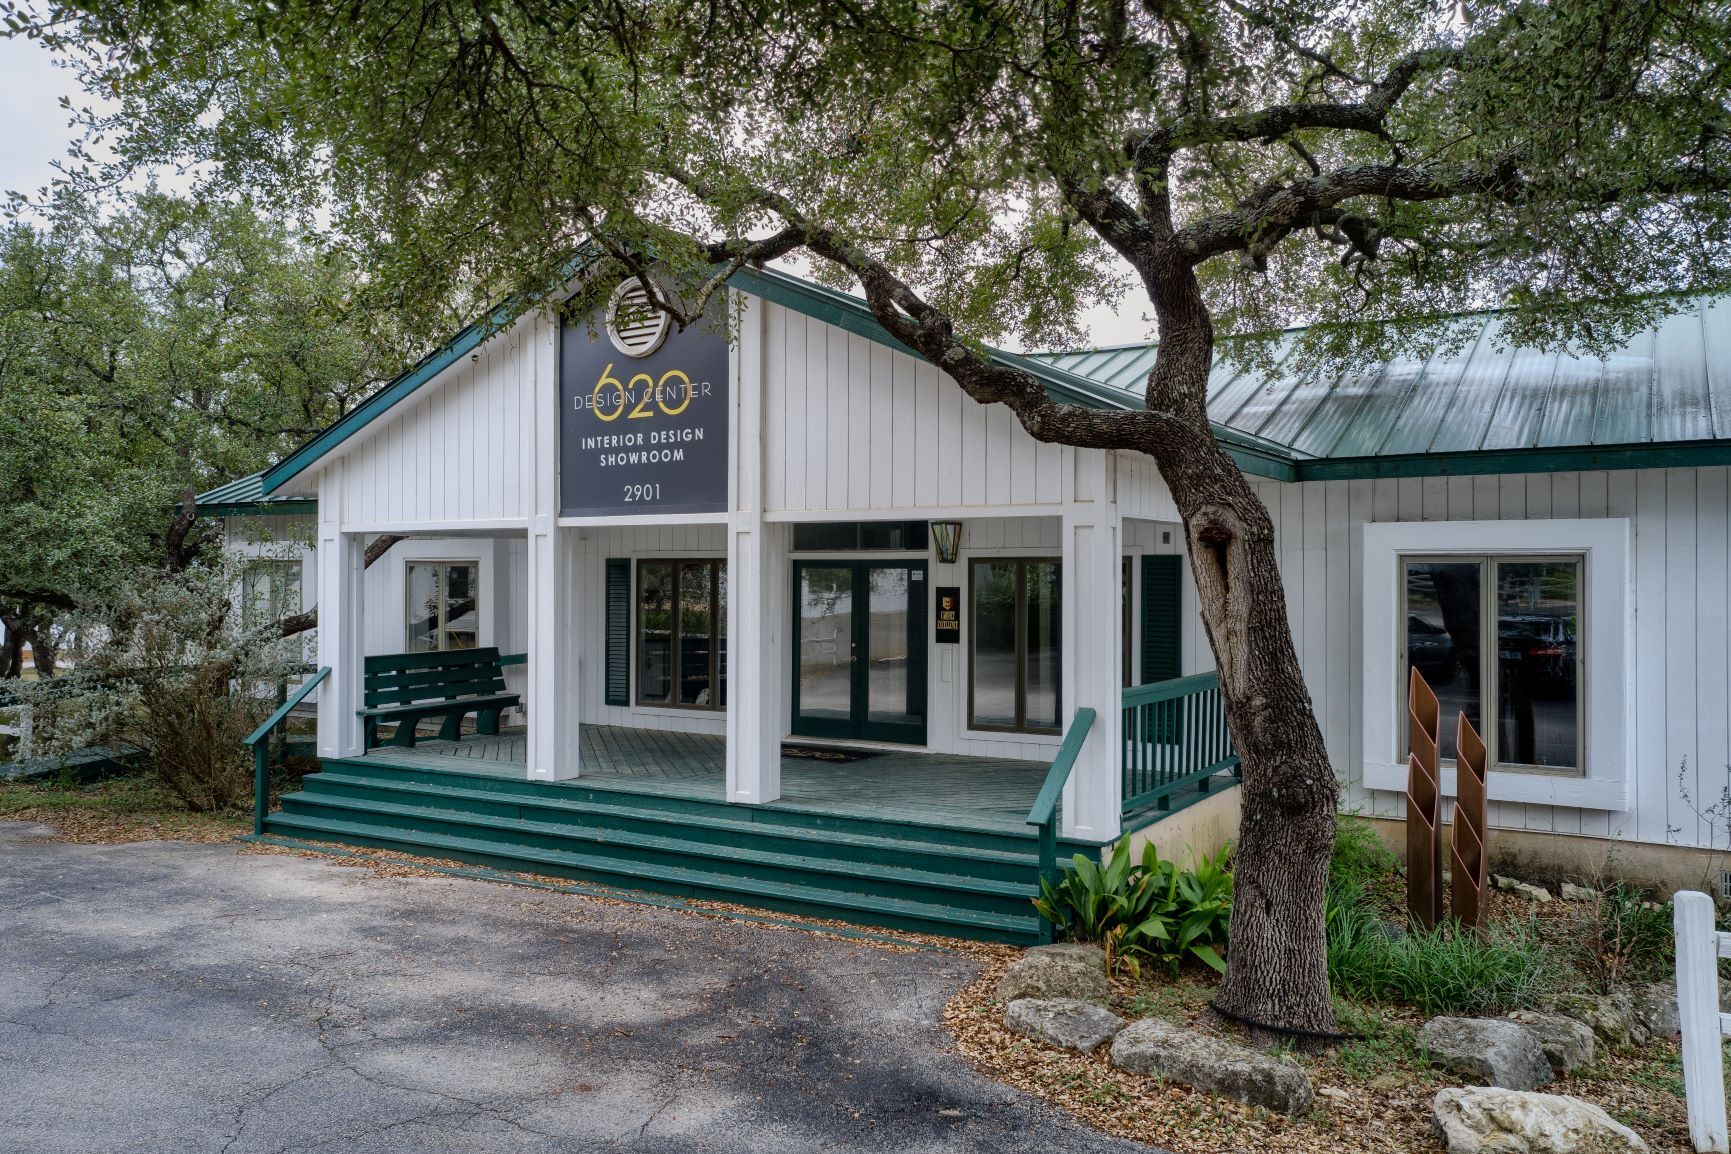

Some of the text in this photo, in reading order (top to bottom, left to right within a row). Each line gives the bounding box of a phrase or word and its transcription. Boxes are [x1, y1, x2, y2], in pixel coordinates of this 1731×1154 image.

[574, 382, 712, 410] DESIGN CENTER
[592, 363, 691, 422] 620
[582, 427, 704, 450] INTERIOR DESIGN
[600, 448, 684, 467] SHOWROOM
[624, 483, 661, 502] 2901
